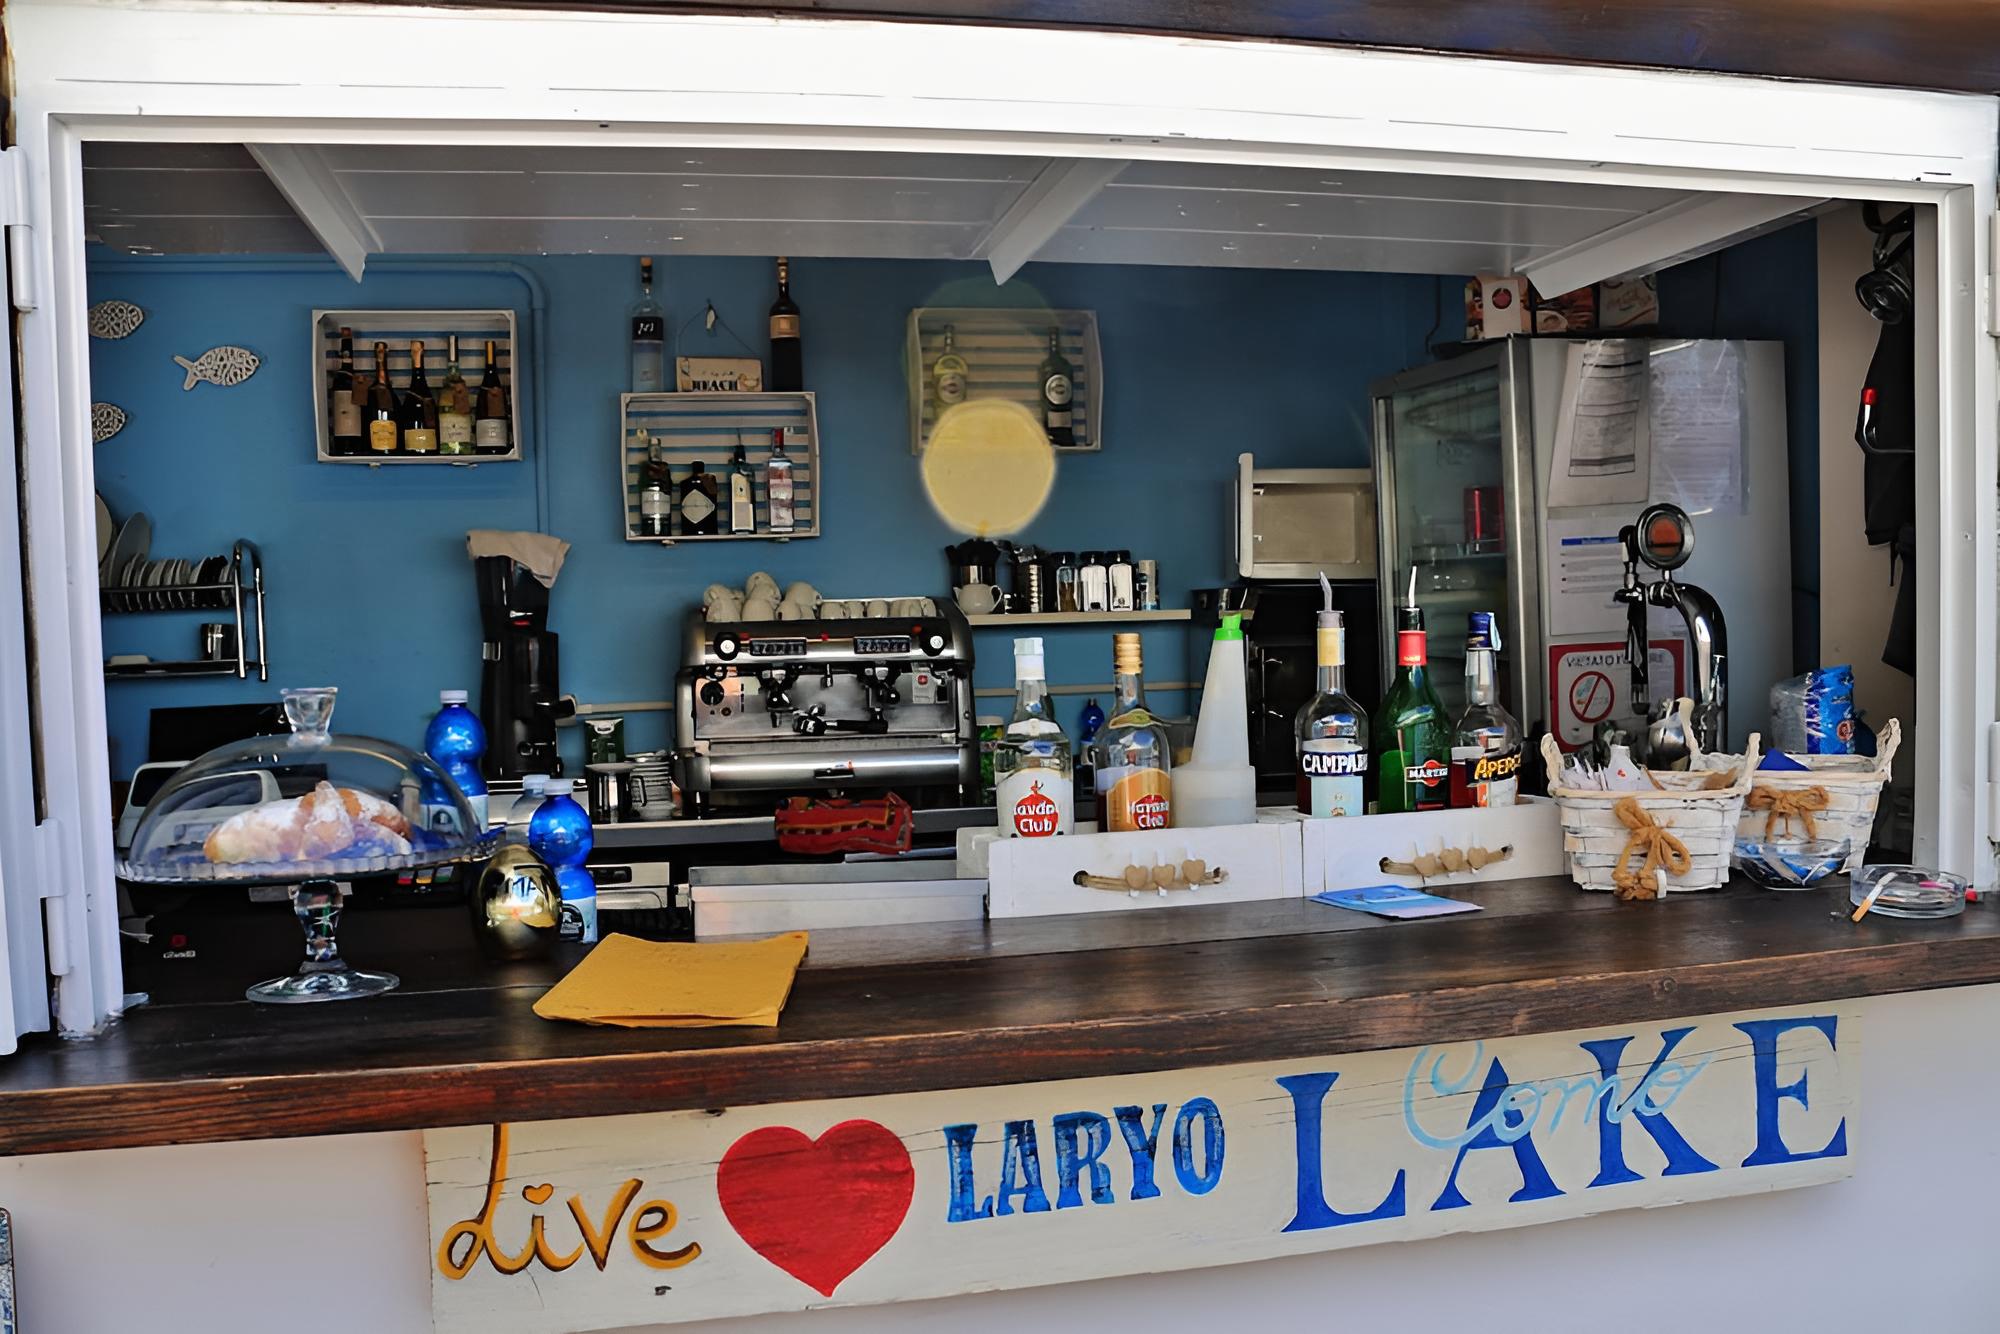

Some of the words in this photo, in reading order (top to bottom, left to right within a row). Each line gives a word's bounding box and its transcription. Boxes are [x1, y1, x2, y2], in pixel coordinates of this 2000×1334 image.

[1474, 752, 1521, 779] APERO
[1020, 818, 1052, 832] Club
[943, 1096, 1225, 1223] LARYO
[1275, 1015, 1847, 1233] LAKE
[1403, 1039, 1712, 1151] Como
